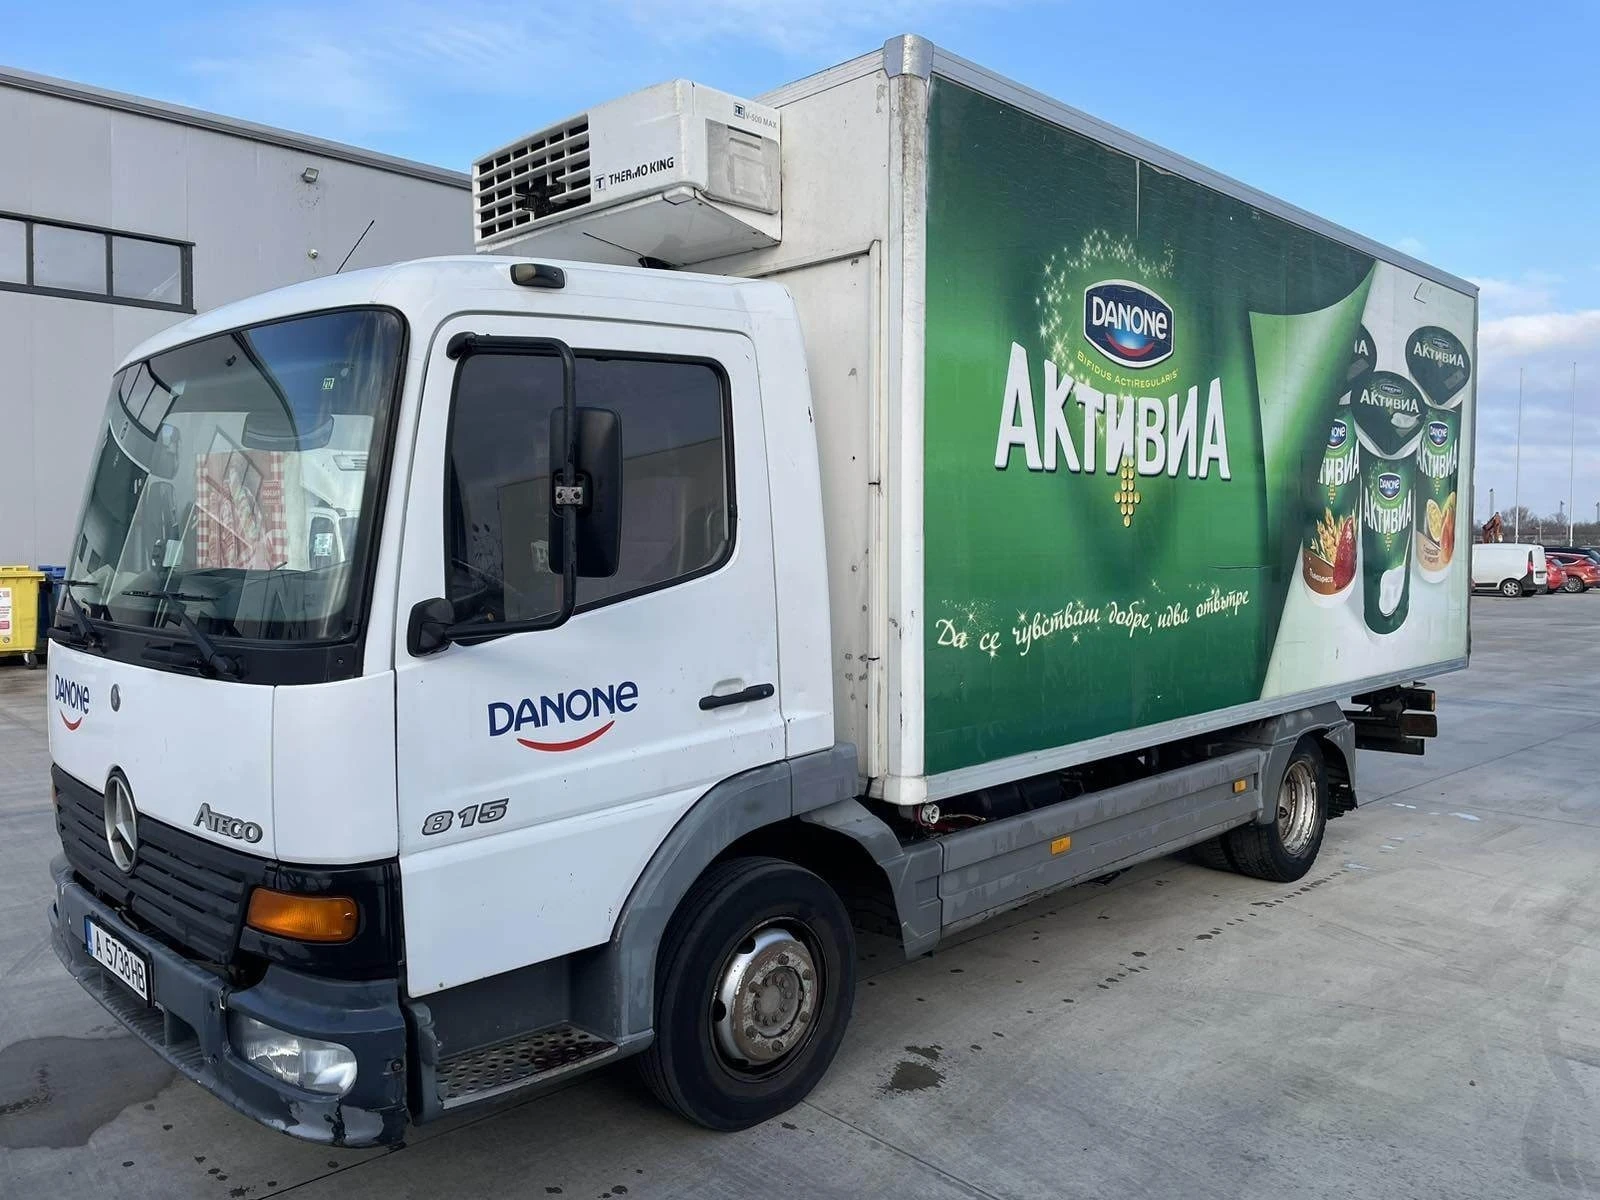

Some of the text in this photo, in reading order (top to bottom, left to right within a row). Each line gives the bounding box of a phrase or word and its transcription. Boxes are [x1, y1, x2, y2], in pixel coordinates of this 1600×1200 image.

[763, 118, 777, 129] MAX
[608, 164, 648, 185] THERMO
[649, 157, 674, 174] KING
[1077, 351, 1112, 381] BIFIDUS
[1413, 341, 1465, 369] АКТИВИА
[994, 341, 1231, 480] АКТИВИА
[1360, 388, 1420, 414] АКТИВИА
[1364, 486, 1412, 534] АКТИВИА
[936, 618, 968, 649] Да
[979, 631, 1002, 651] се
[1012, 602, 1100, 656] чувстваш
[1157, 602, 1190, 628] идва
[421, 798, 510, 836] 815
